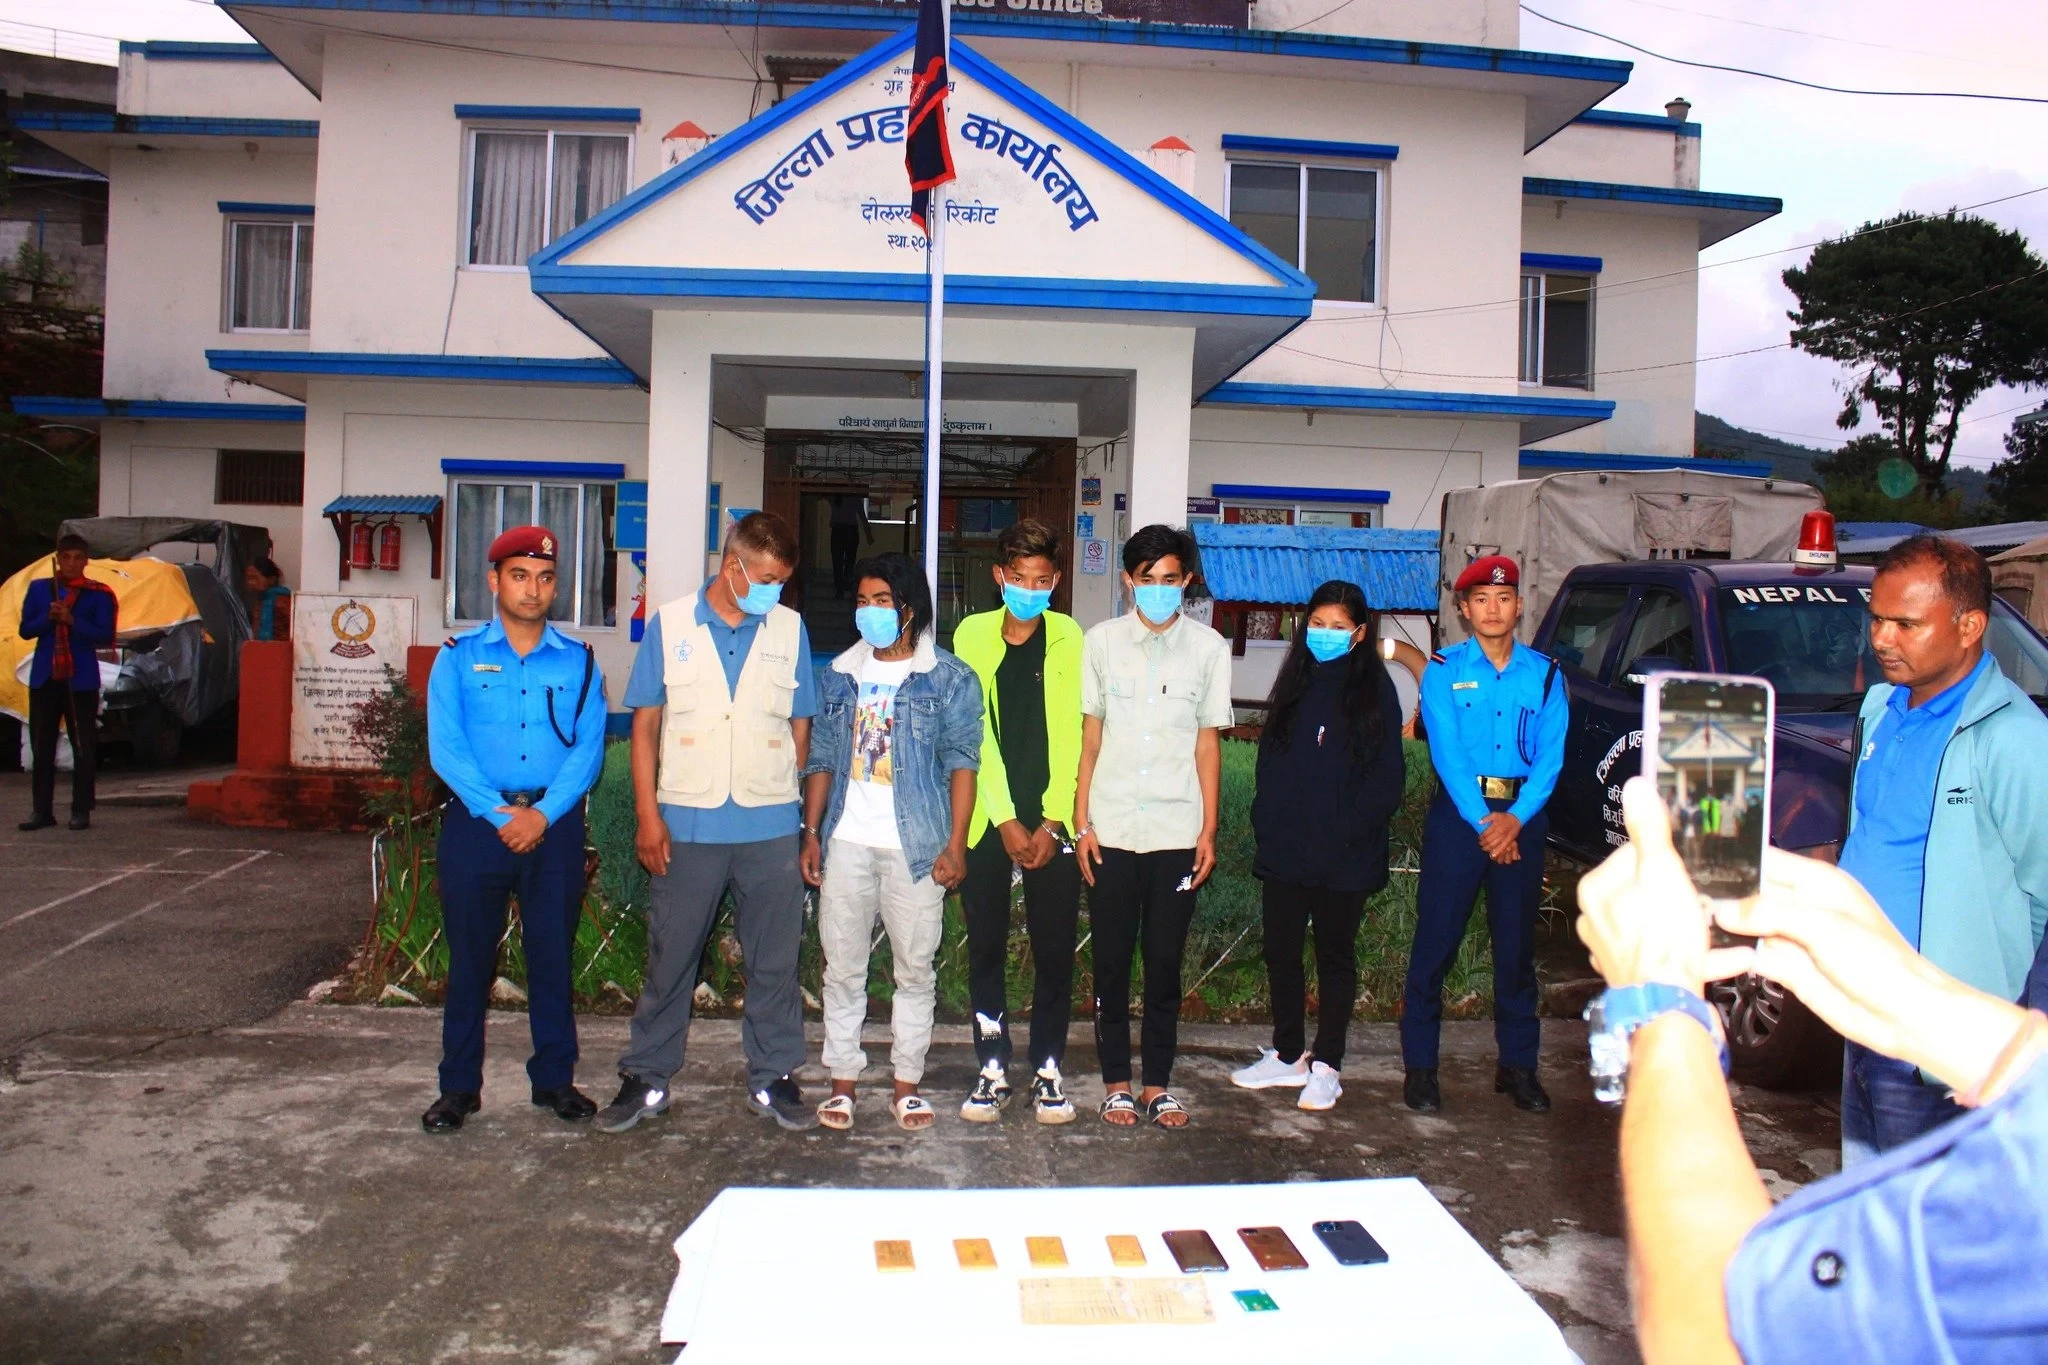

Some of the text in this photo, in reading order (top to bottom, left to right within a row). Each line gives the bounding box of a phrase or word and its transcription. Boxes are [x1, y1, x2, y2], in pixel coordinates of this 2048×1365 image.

[893, 66, 913, 76] नेपा
[884, 80, 904, 96] गृह
[734, 105, 1099, 232] जिल्ला प्रह कार्यालय
[931, 199, 999, 226] रिकोट
[1732, 587, 1848, 604] NEPAL
[1596, 730, 1644, 784] जिल्ला प्रह
